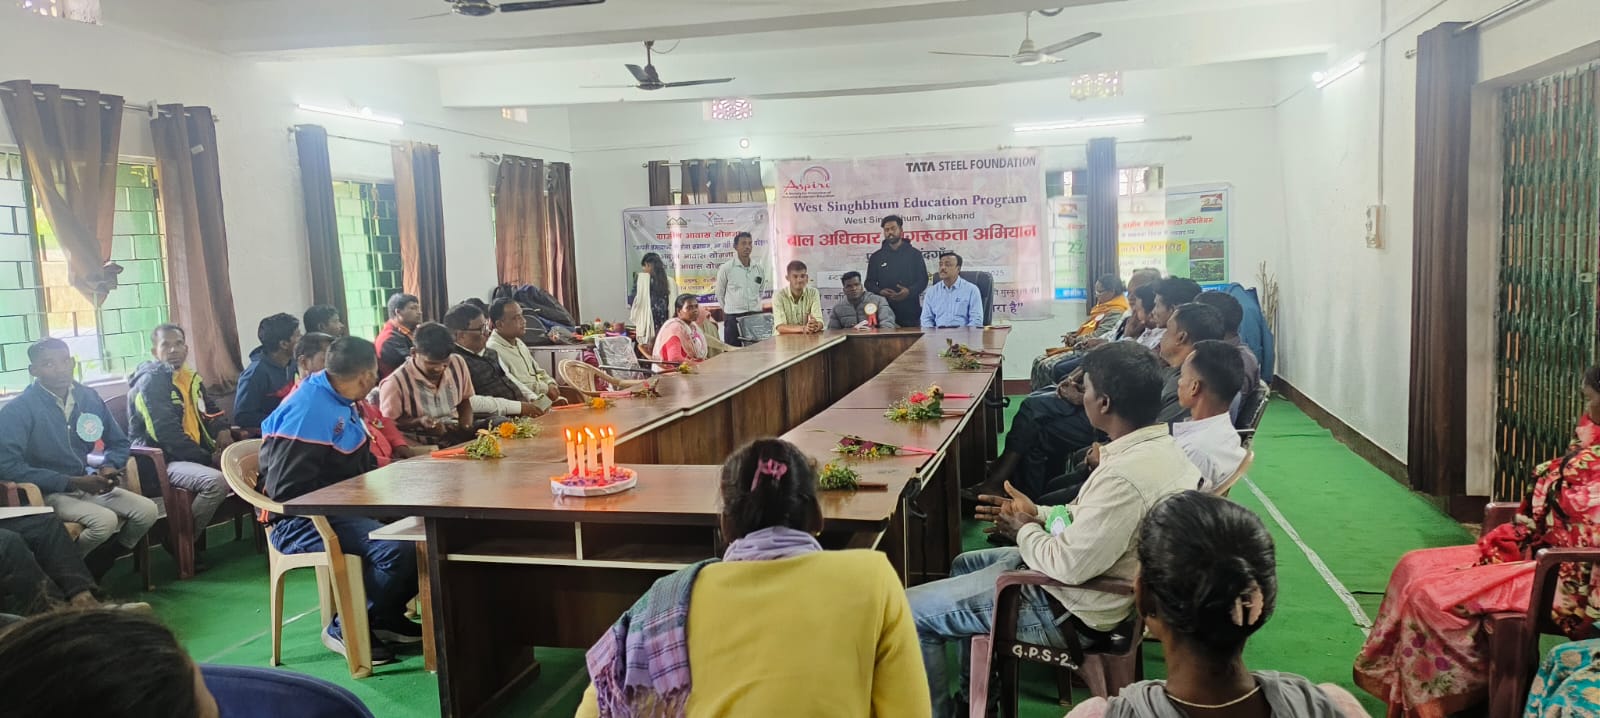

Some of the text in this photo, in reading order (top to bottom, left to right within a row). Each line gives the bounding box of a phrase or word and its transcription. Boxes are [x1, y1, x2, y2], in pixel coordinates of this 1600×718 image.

[905, 156, 1036, 173] TATA STEEL FOUNDATION
[794, 194, 1028, 215] West Singhbhum Education Program
[844, 212, 975, 225] West Sinhum, Jharkhand
[787, 223, 1036, 247] बाल अधिकार गरूकता अभियान
